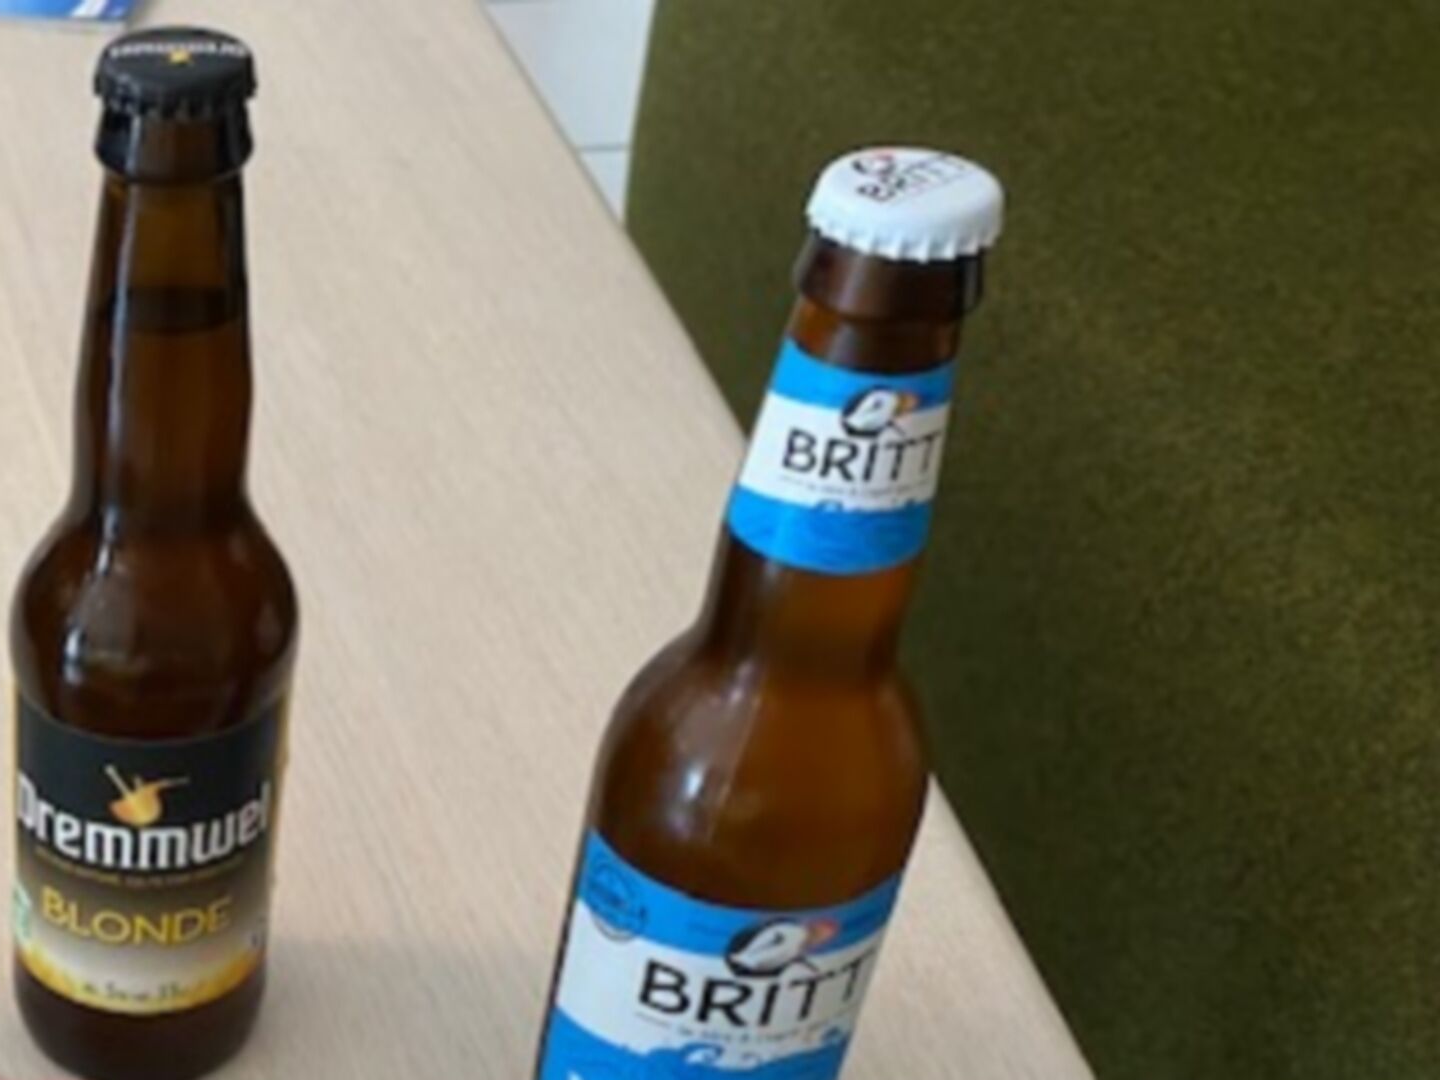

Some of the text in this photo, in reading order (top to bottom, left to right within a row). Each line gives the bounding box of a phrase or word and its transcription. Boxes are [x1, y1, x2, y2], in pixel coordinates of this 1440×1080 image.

[781, 428, 942, 483] BRITT
[40, 885, 232, 944] BLONDE
[637, 946, 876, 1028] BRITT
